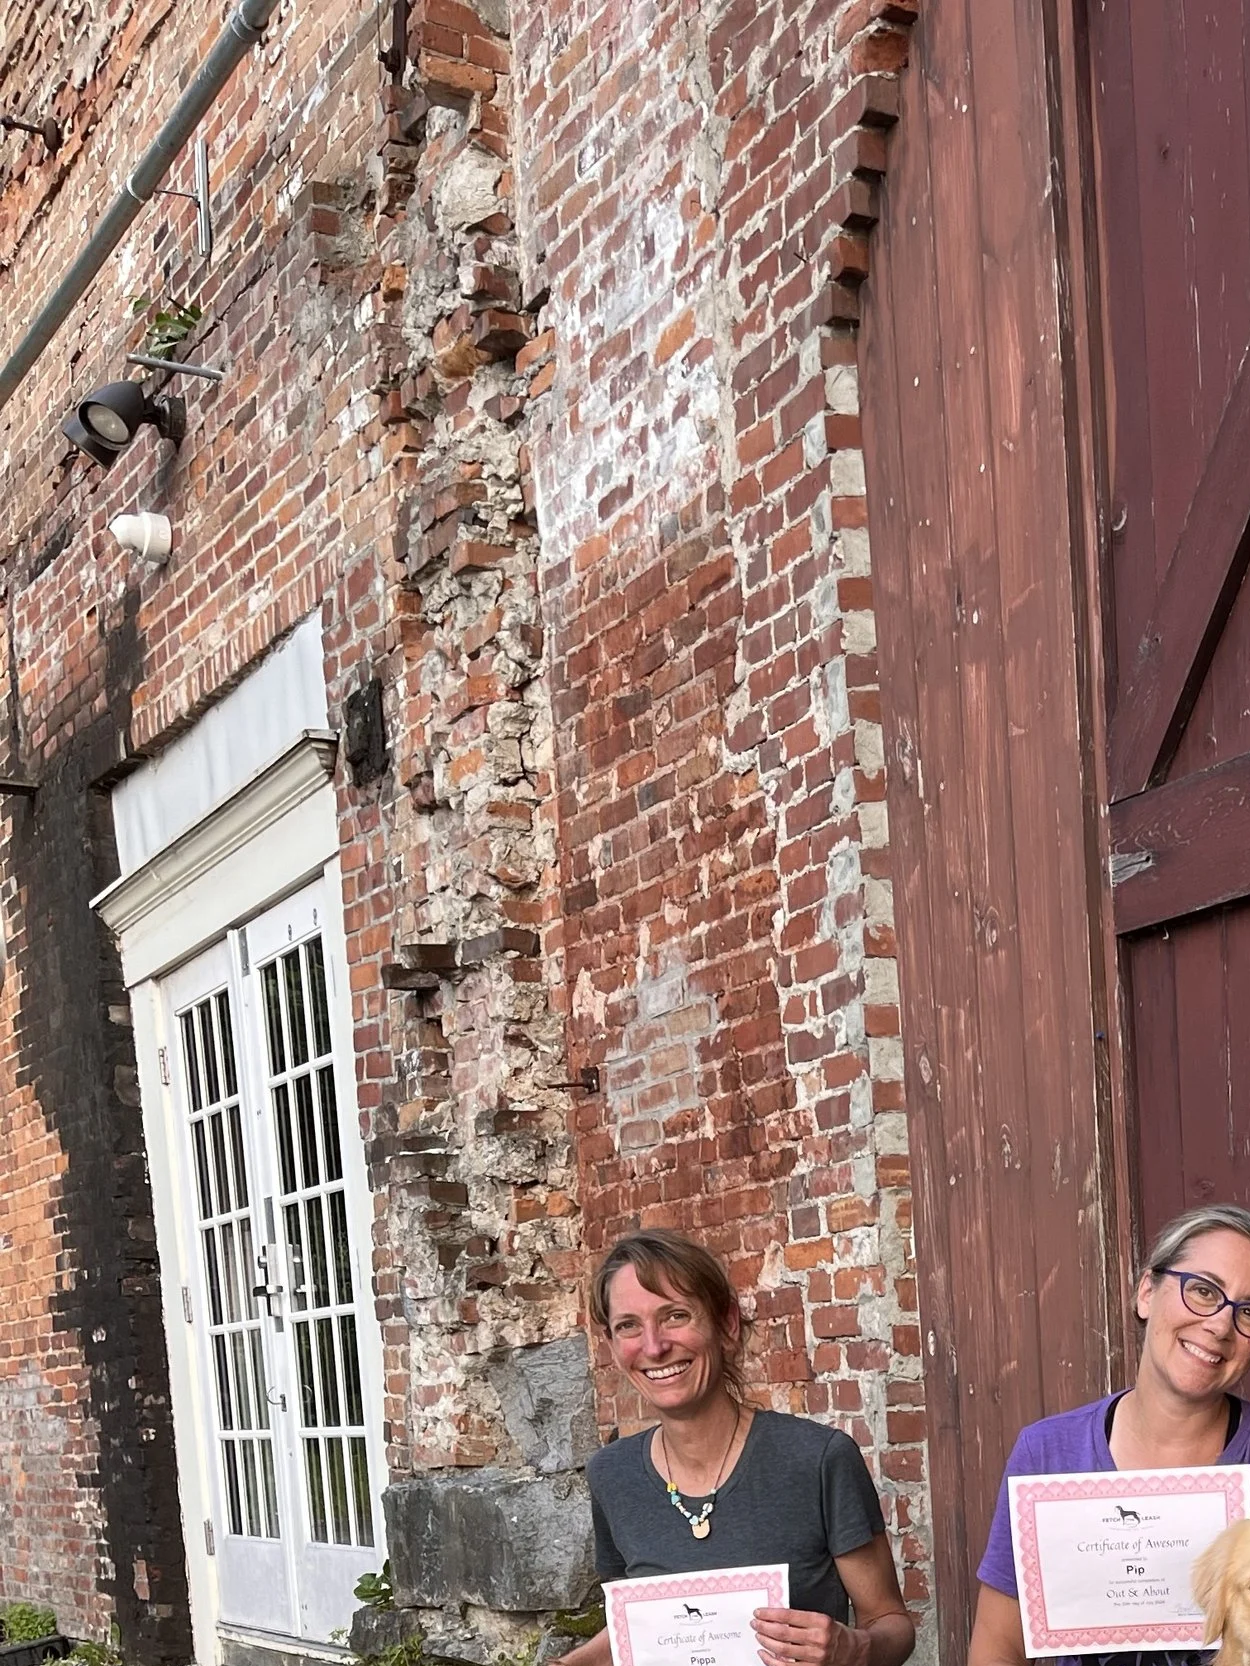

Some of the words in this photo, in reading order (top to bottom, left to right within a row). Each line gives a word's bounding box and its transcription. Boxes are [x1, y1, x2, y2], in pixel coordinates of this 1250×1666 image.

[1076, 1538, 1130, 1556] Certificate
[1132, 1536, 1143, 1555] of
[1145, 1538, 1190, 1549] Awesome
[1126, 1564, 1145, 1576] Pip
[1106, 1588, 1125, 1599] Out
[1127, 1587, 1139, 1598] &
[1142, 1585, 1170, 1597] About
[657, 1632, 697, 1649] Certificate
[707, 1630, 742, 1641] Awesome
[690, 1656, 716, 1666] Pippa
